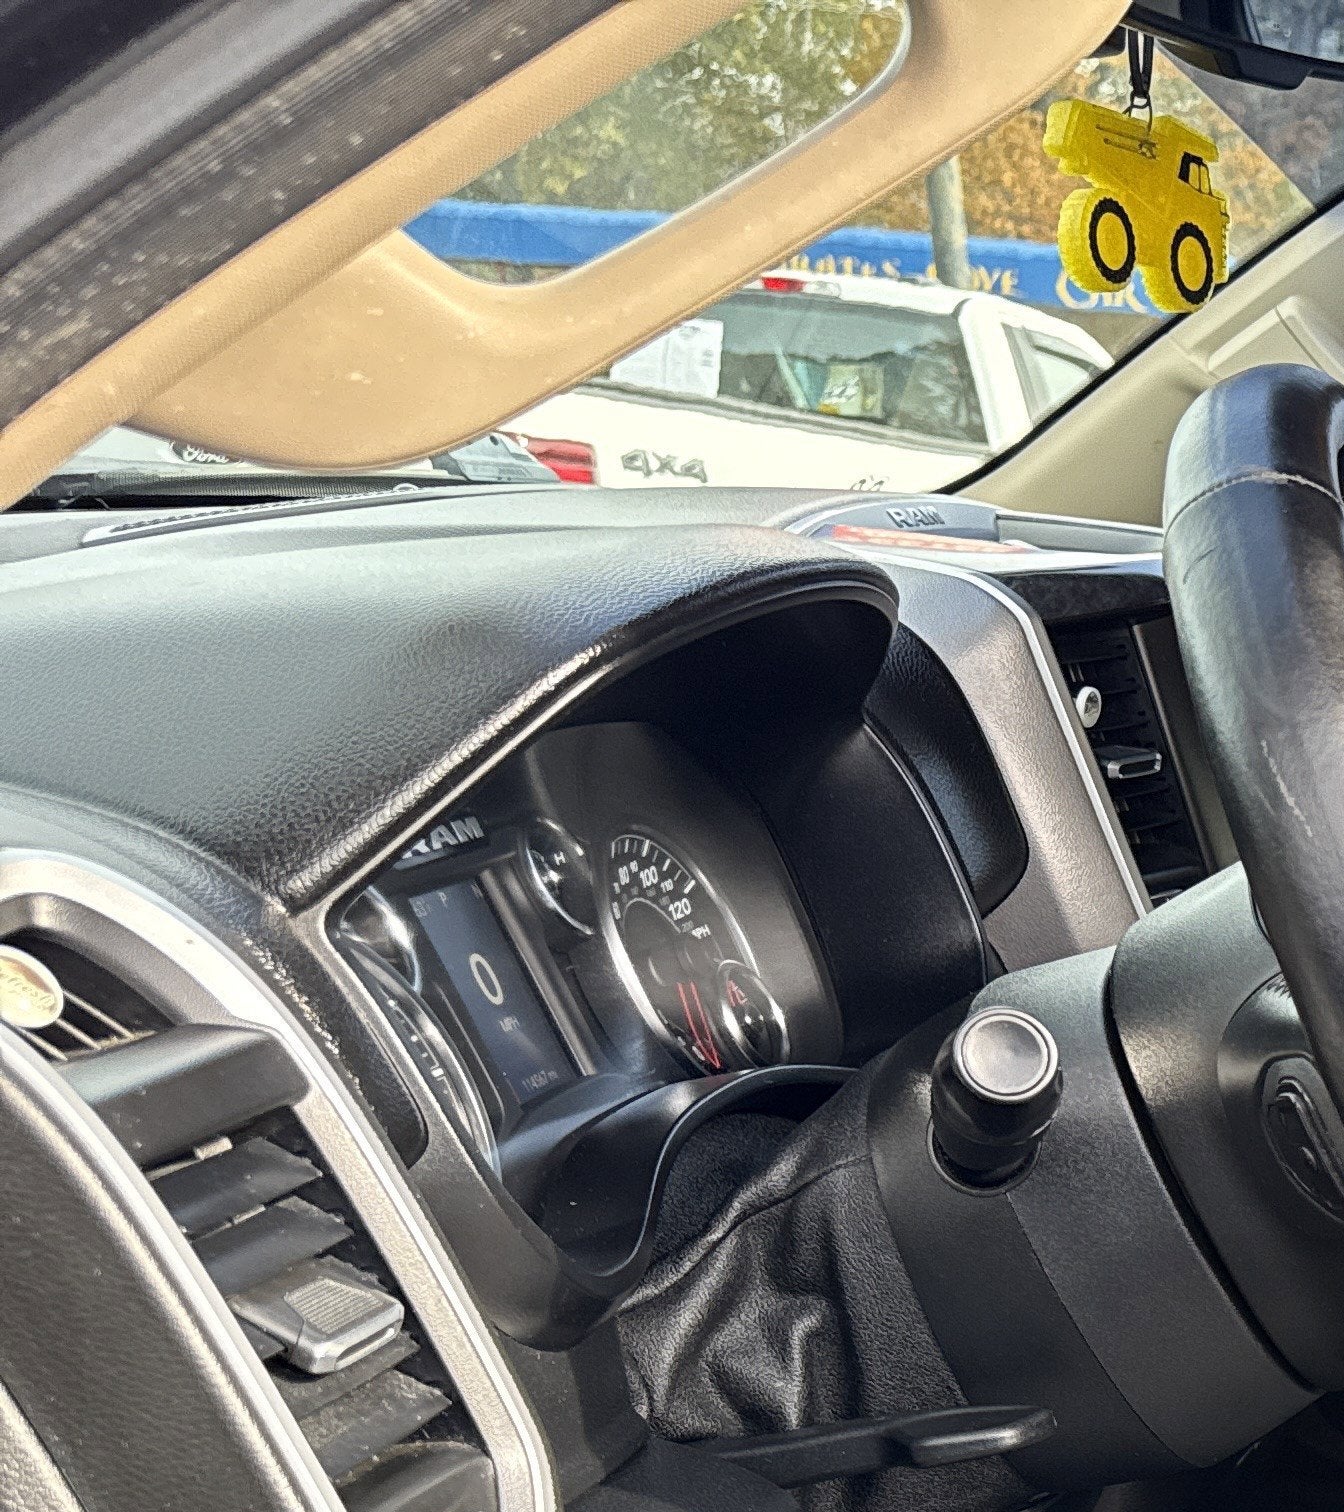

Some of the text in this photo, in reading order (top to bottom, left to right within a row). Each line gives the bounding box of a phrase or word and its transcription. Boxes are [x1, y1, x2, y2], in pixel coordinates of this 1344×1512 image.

[885, 505, 946, 528] RAM
[639, 865, 659, 889] 100
[668, 897, 692, 921] 120
[469, 952, 505, 1006] 0
